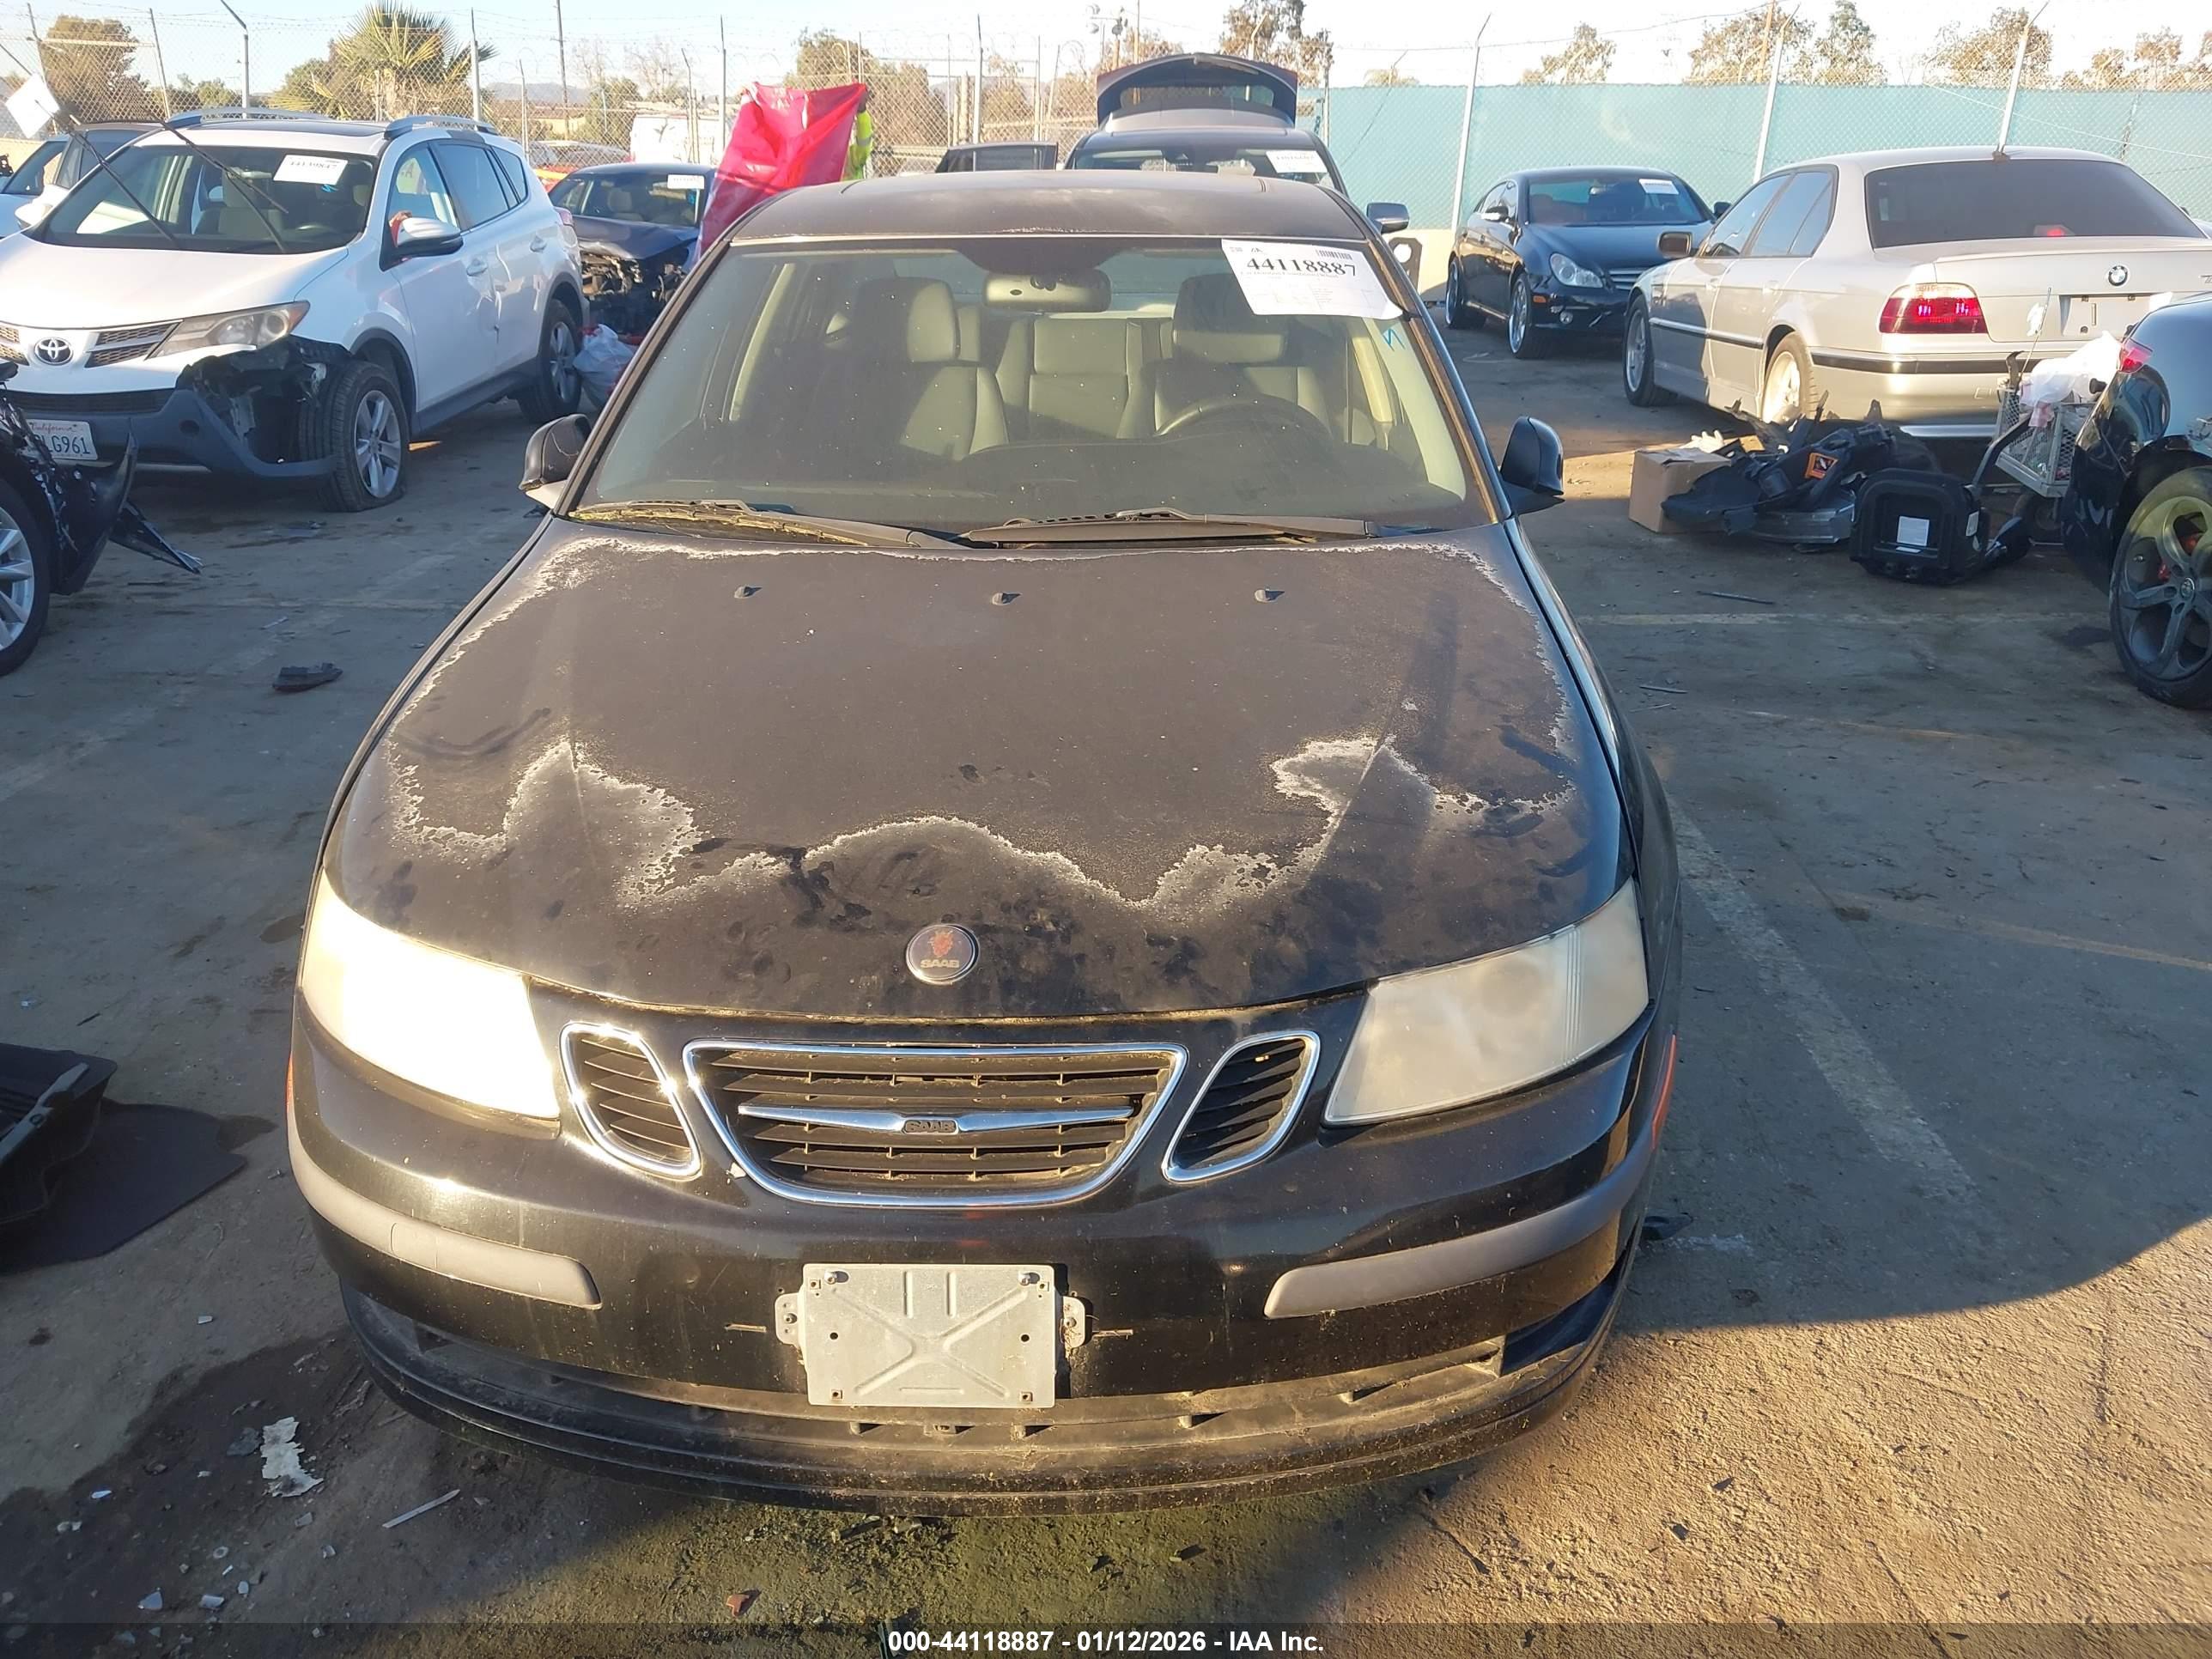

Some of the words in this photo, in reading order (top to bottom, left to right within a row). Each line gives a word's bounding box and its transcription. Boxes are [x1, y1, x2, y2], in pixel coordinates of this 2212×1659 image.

[1247, 258, 1356, 276] 44118887
[920, 958, 960, 969] SAAB
[905, 1119, 957, 1133] SAAB
